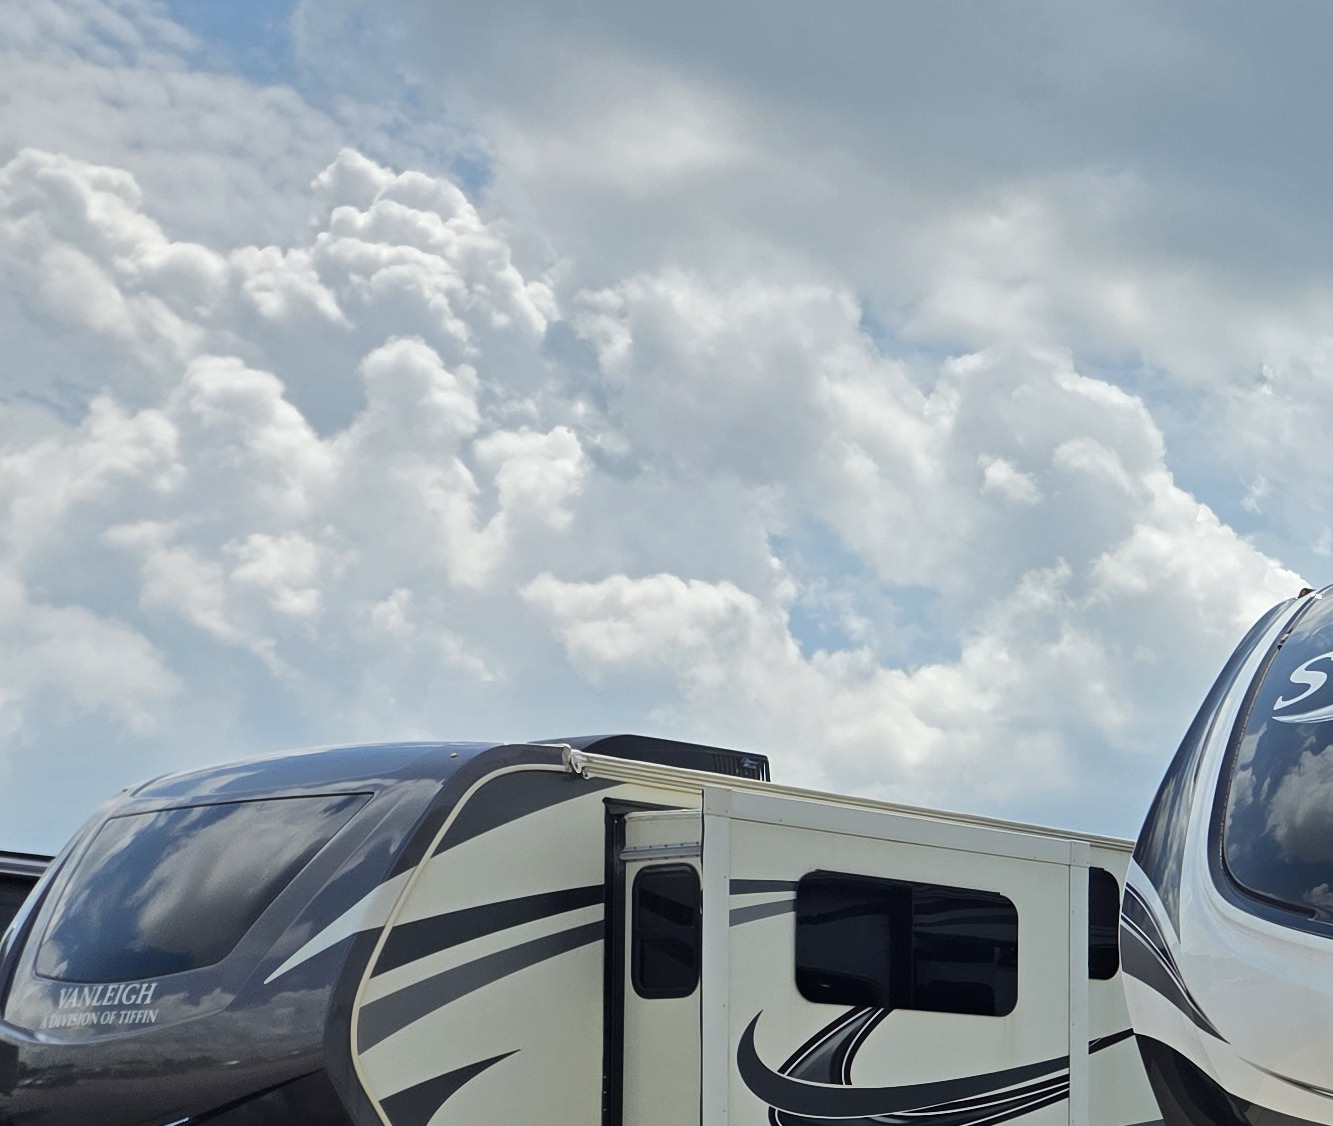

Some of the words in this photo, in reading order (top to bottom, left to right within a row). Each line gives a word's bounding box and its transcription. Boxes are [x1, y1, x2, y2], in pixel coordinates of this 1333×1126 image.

[58, 982, 158, 1009] VANLEIGH
[48, 1011, 99, 1029] DIVISION
[100, 1011, 118, 1025] OF
[119, 1009, 159, 1025] TIFFIN
